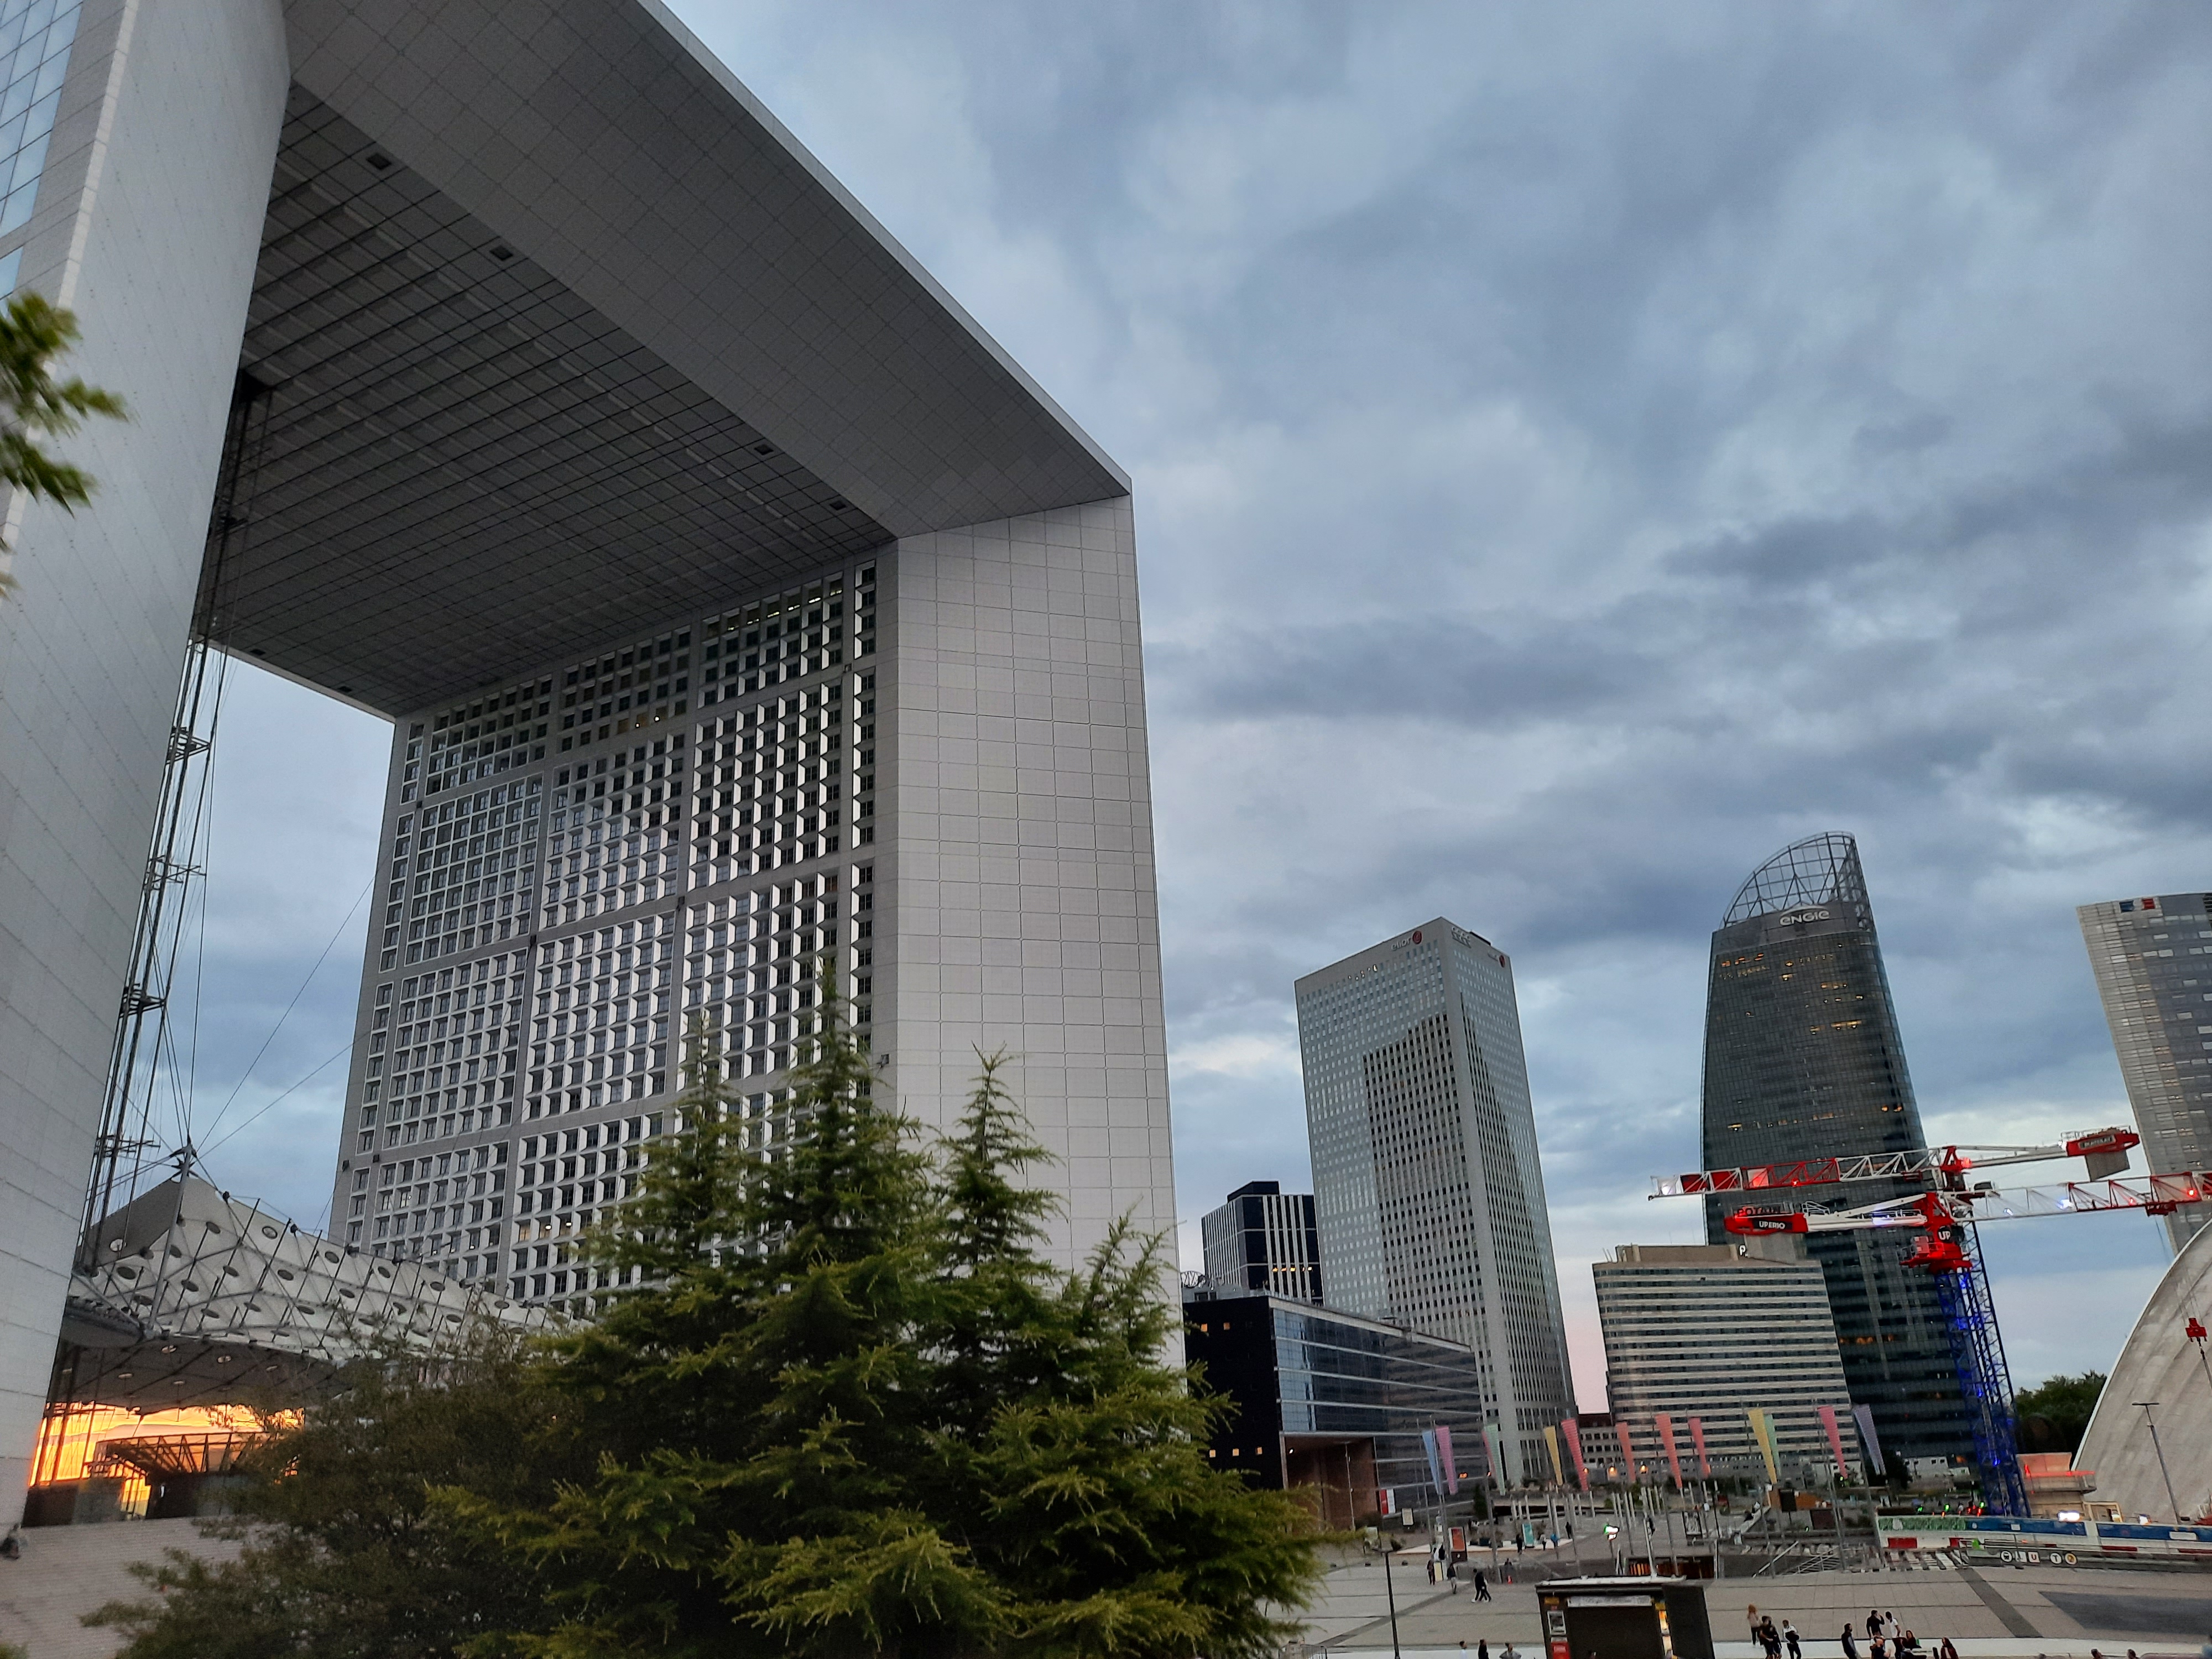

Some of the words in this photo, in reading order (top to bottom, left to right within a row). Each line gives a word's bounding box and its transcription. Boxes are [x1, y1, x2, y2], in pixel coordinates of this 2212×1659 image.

[1391, 937, 1412, 951] elior
[1759, 1220, 1786, 1230] UPERIO
[1938, 1230, 1951, 1240] UP
